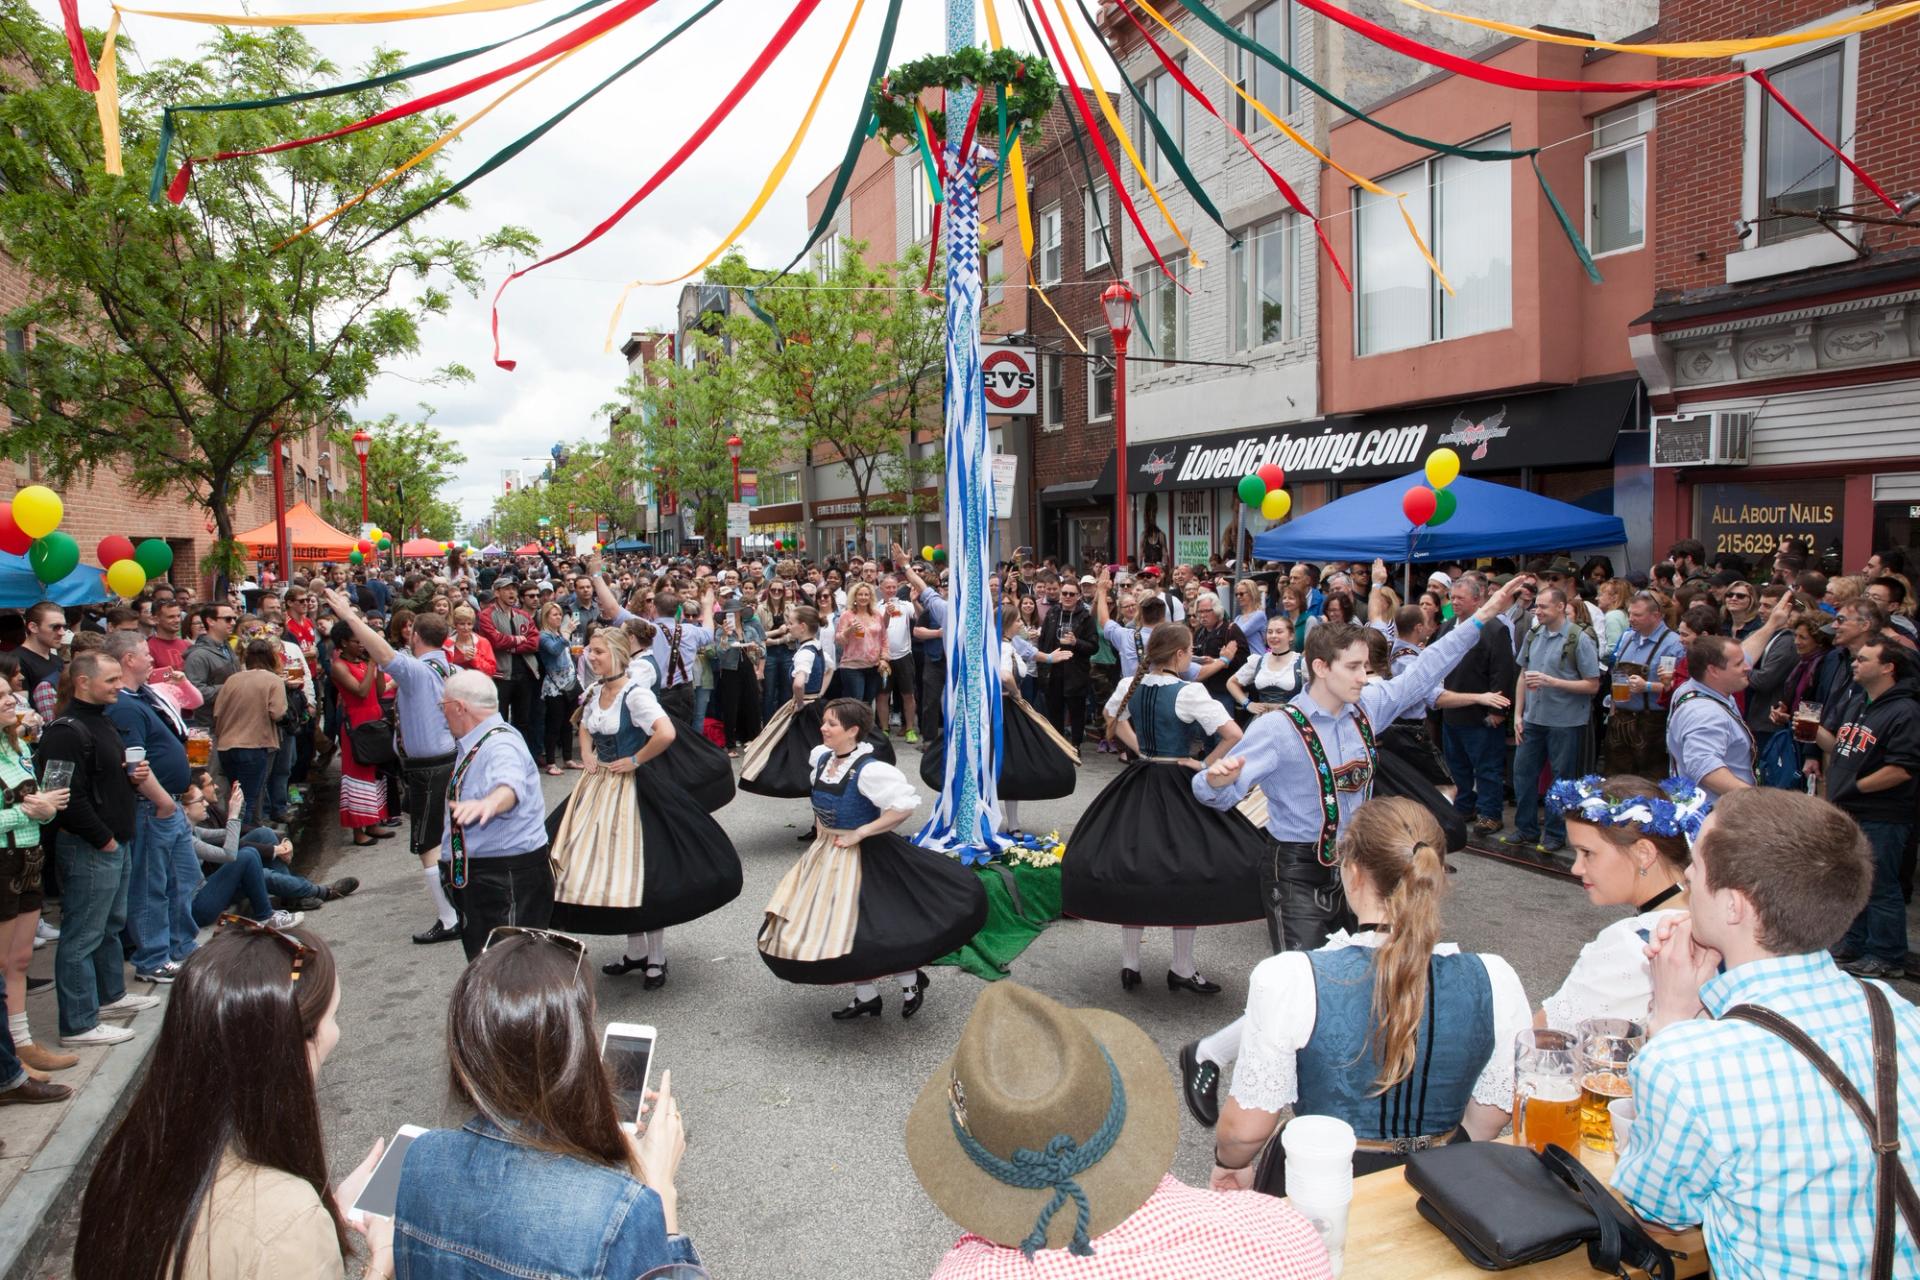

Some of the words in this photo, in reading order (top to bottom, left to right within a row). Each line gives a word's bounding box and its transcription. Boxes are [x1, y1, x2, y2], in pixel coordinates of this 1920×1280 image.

[1177, 424, 1428, 481] iLoveKickboxing.com
[1181, 490, 1205, 514] FIGHT
[1712, 504, 1737, 524] ALL
[1740, 504, 1787, 524] ABOUT
[1790, 503, 1833, 524] NAILS
[1178, 515, 1192, 536] THE
[1193, 515, 1209, 536] FAT!
